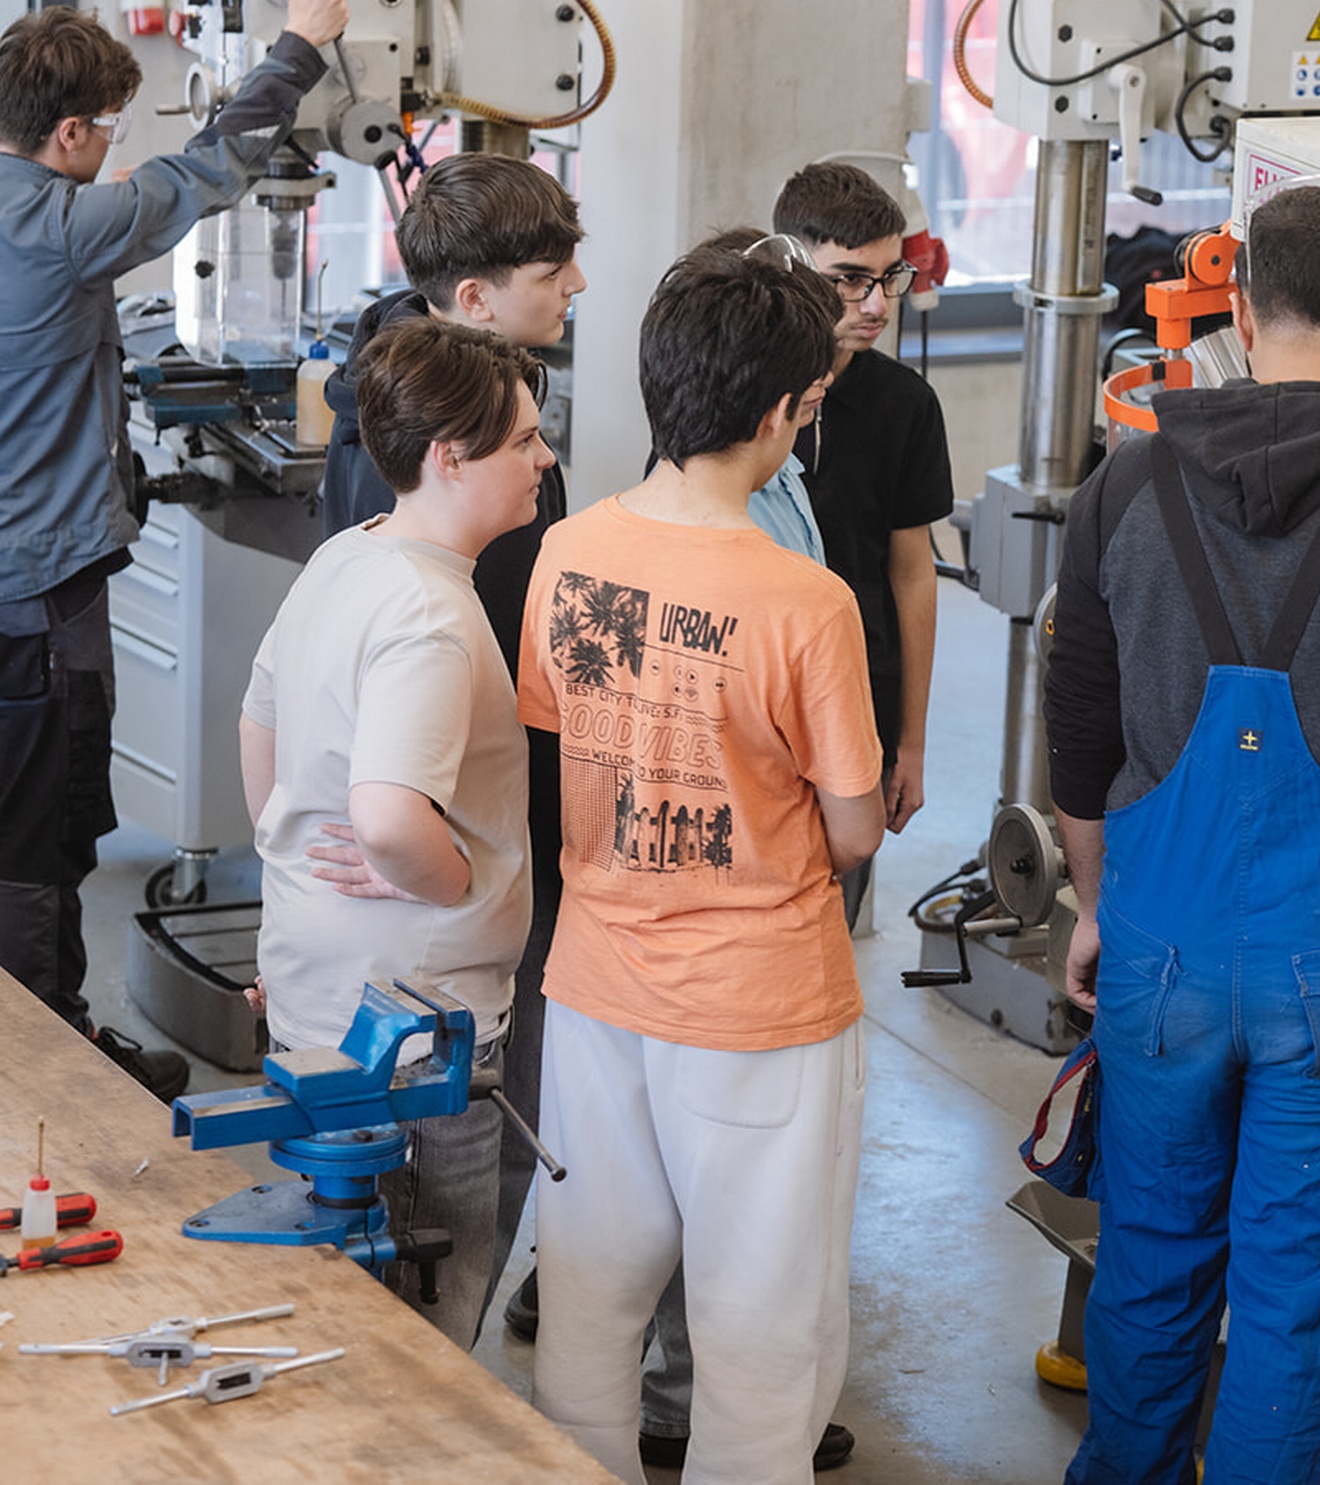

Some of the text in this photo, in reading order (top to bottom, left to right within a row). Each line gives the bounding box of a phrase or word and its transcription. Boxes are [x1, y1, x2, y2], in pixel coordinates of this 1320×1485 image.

[565, 683, 595, 697] BEST
[599, 690, 622, 706] CITY
[639, 722, 723, 769] VIBES
[649, 767, 680, 780] YOUR
